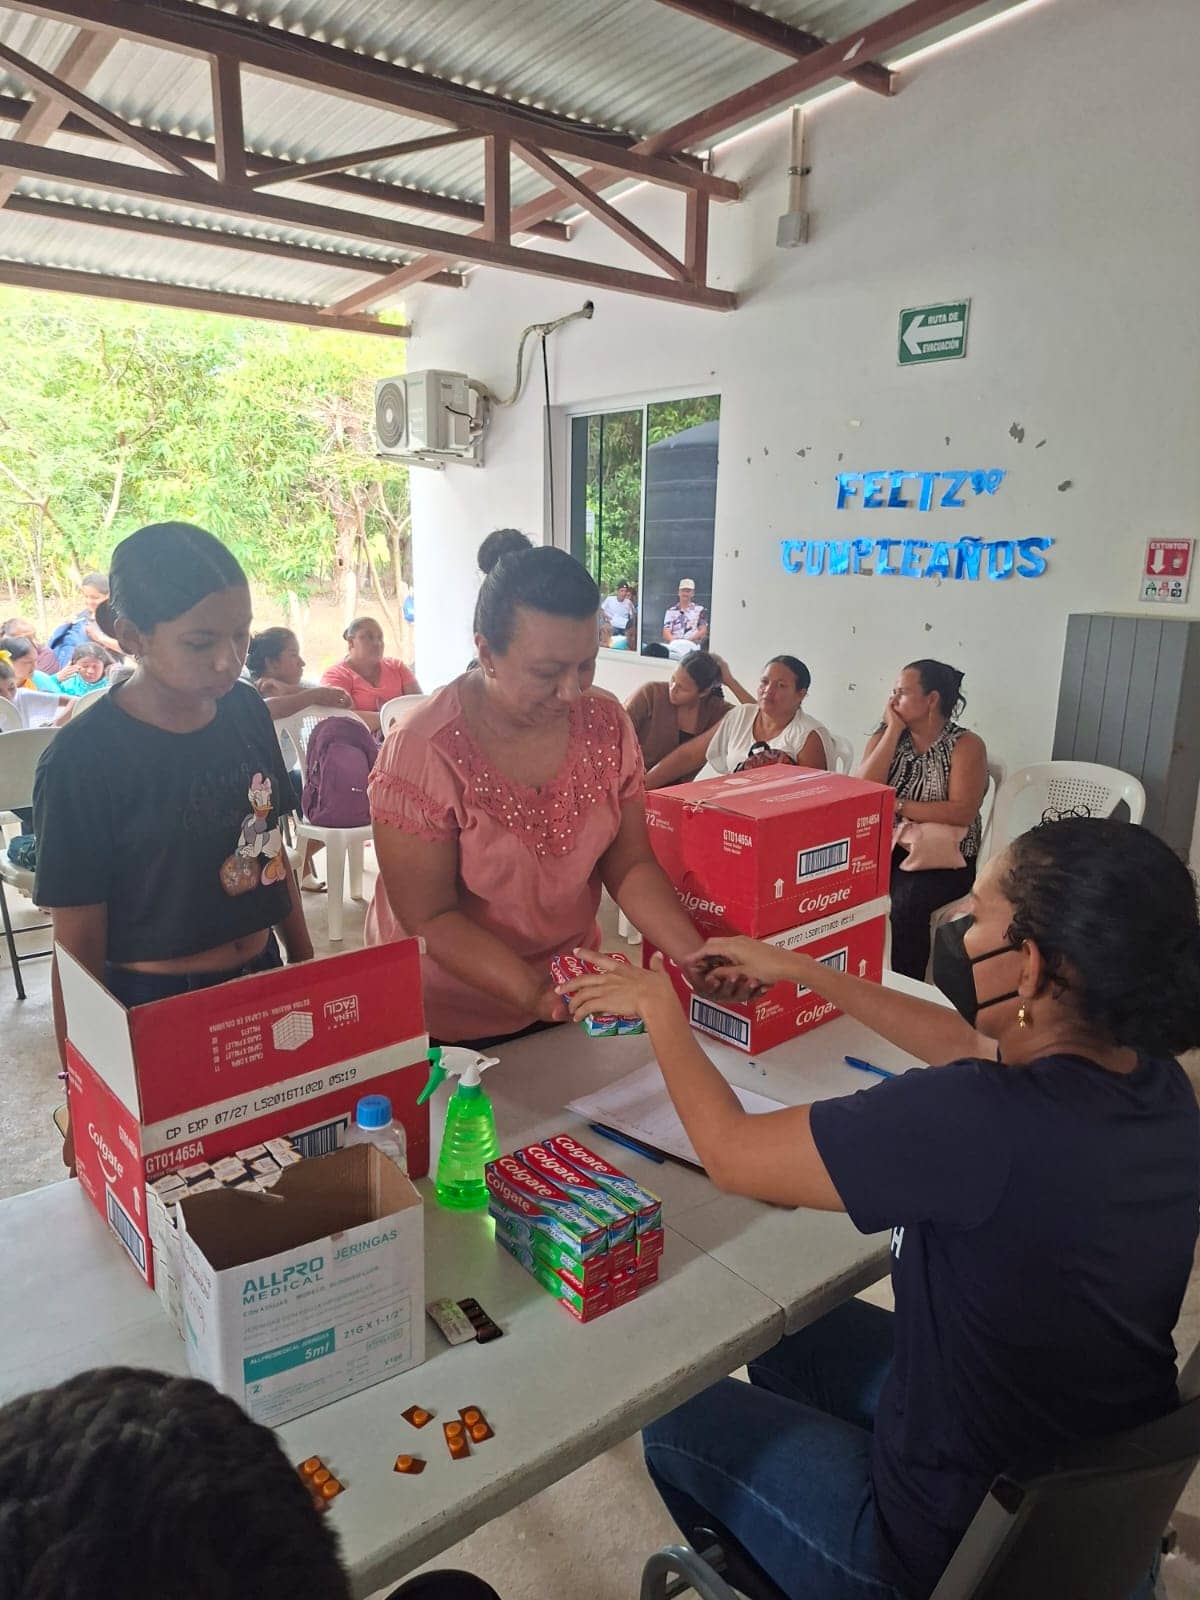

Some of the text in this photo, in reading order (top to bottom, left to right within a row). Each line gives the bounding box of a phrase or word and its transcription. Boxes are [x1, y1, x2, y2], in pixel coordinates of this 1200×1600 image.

[928, 312, 959, 325] RUTA DE
[836, 470, 969, 512] FELIZ
[781, 535, 1055, 581] CUMPLEAÑOS
[646, 813, 656, 827] 72
[852, 861, 861, 875] 72
[676, 890, 725, 916] olgate
[798, 887, 851, 914] Colgate
[755, 1007, 766, 1022] 72
[166, 1126, 182, 1140] CP
[188, 1118, 209, 1134] EXP
[215, 1104, 248, 1125] 07/27
[328, 1068, 357, 1086] 05:19
[88, 1122, 124, 1178] Colgate
[145, 1141, 204, 1174] GT01465A
[527, 1146, 580, 1184] Colgate
[555, 1136, 608, 1172] Colgate
[486, 1172, 530, 1212] Colgate
[499, 1157, 552, 1196] Colgate
[333, 1229, 398, 1260] JERINGAS
[242, 1256, 324, 1295] ALLPRO
[242, 1273, 324, 1306] MEDICAL
[304, 1342, 330, 1360] 5ml
